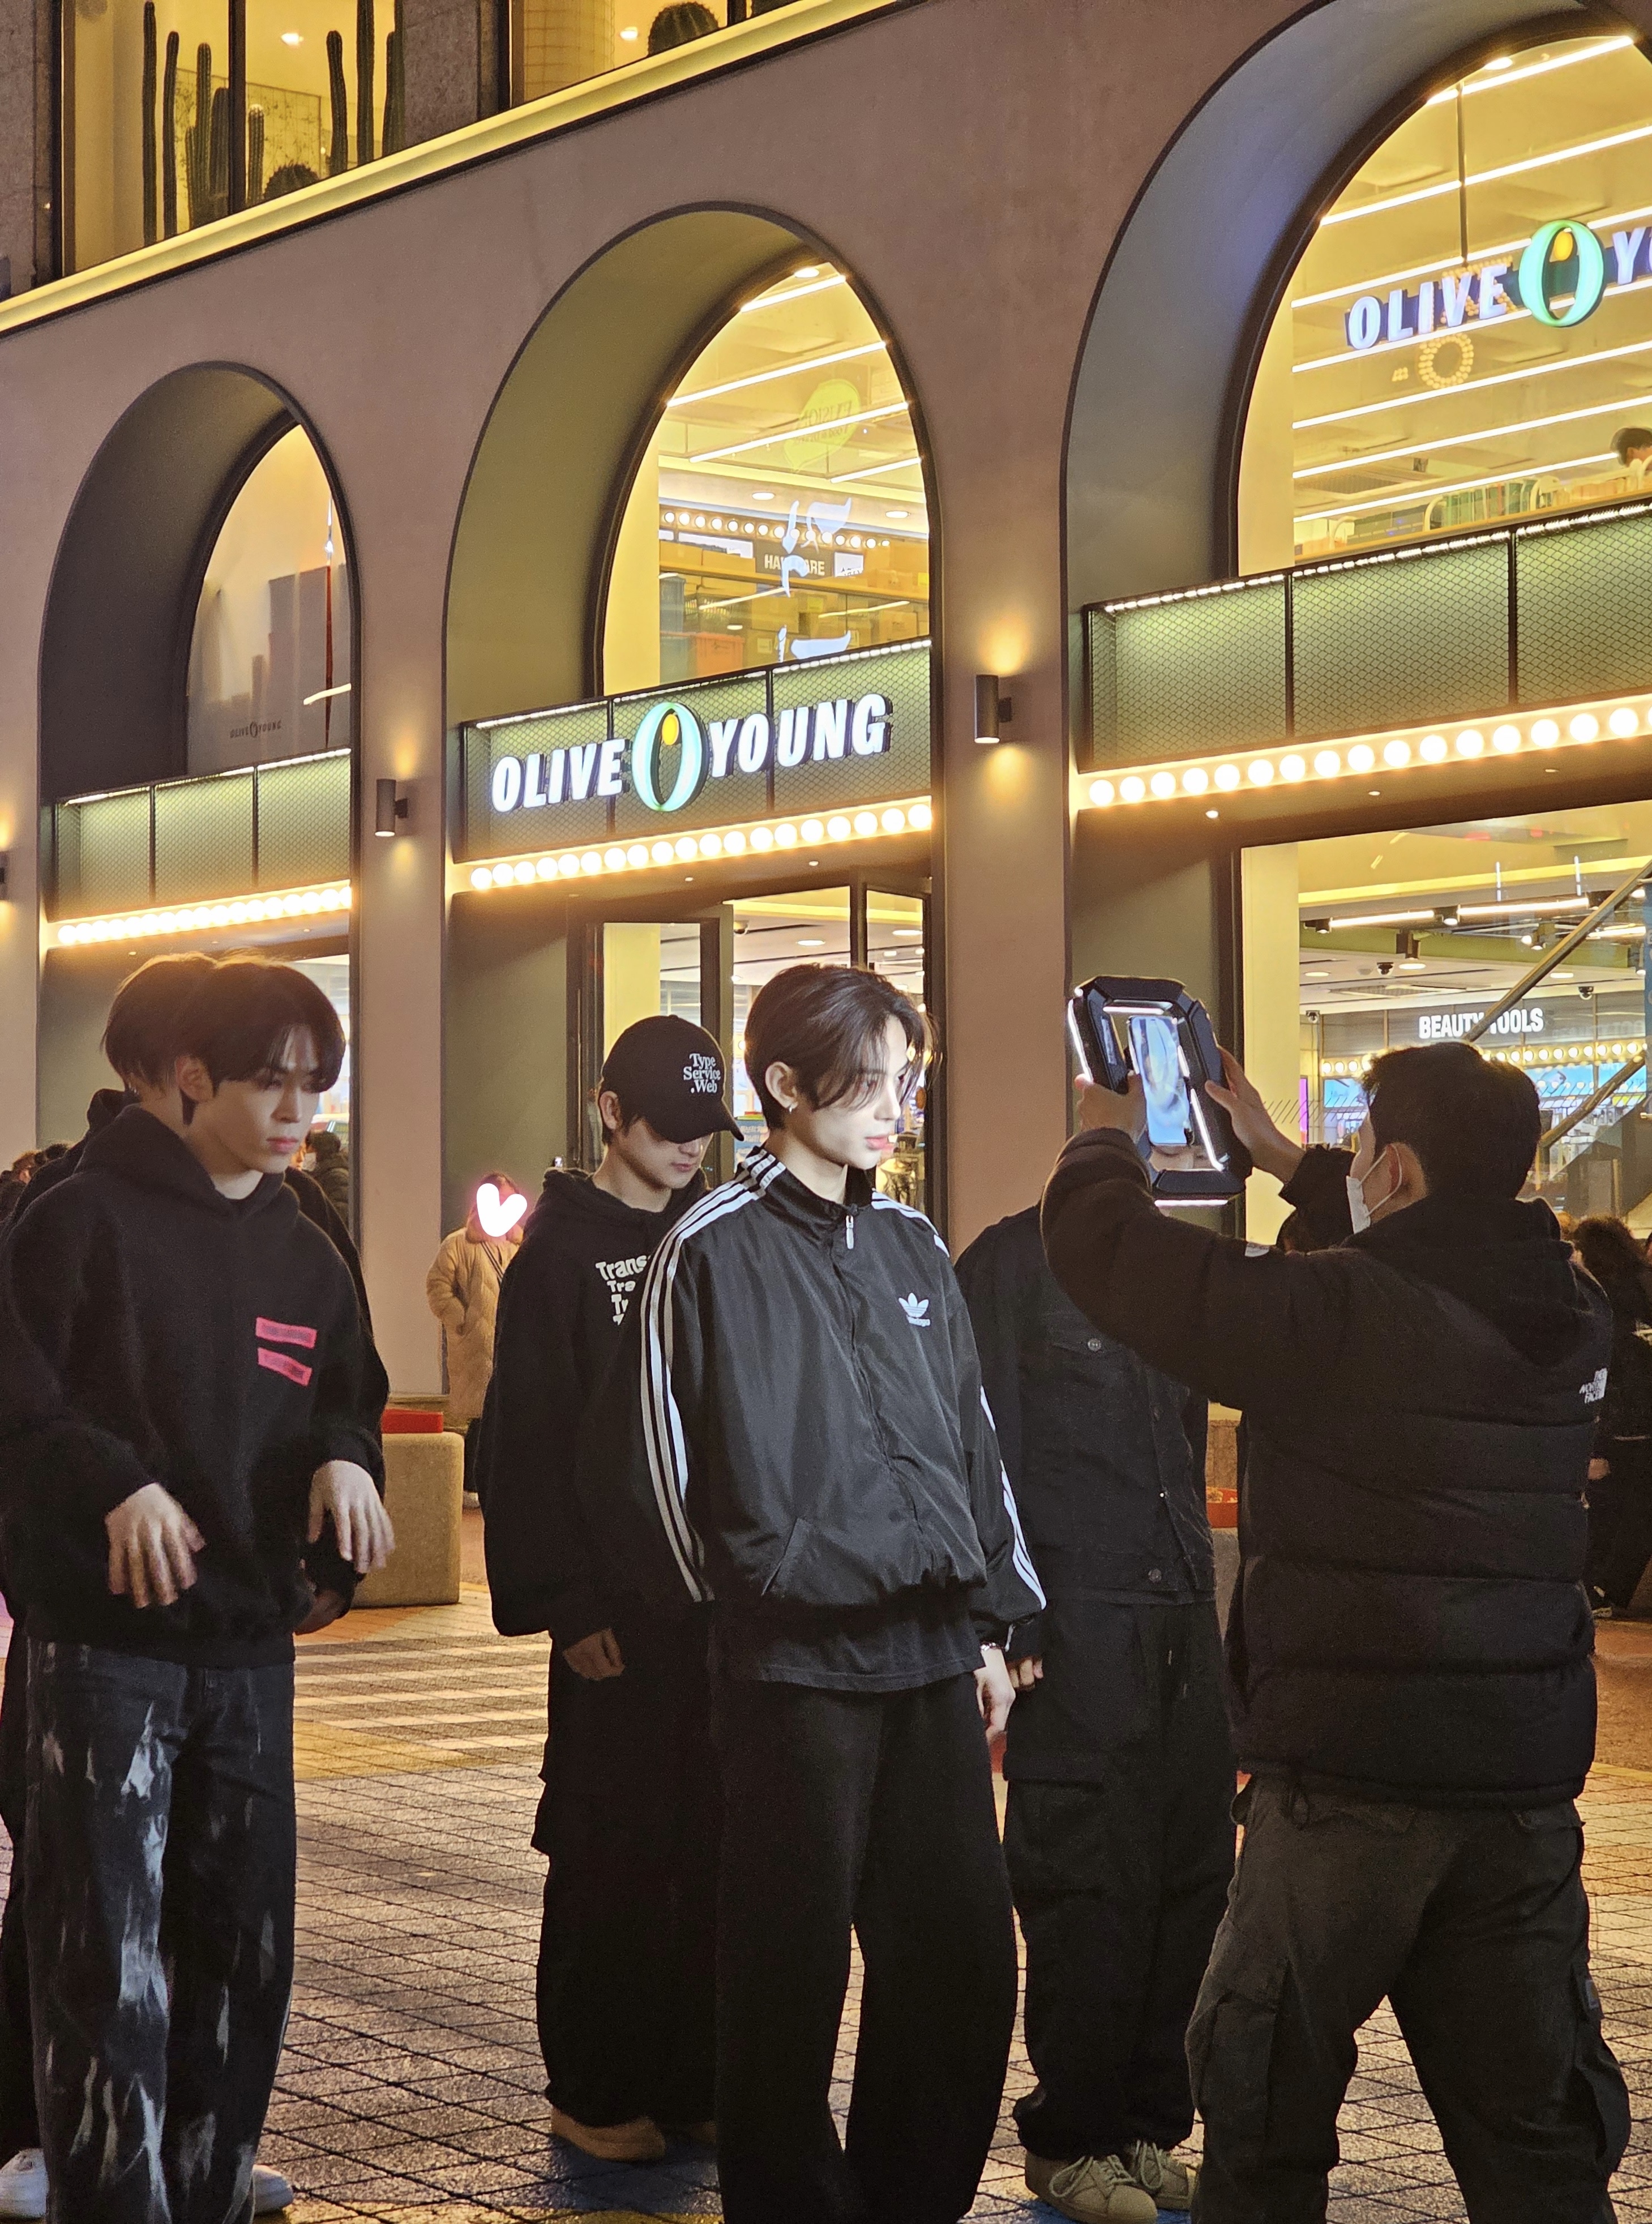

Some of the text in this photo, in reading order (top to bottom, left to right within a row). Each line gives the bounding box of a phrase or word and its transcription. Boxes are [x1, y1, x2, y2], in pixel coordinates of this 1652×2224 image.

[1348, 264, 1508, 350] OLIVE
[1612, 226, 1652, 285] Y
[764, 554, 785, 570] HA
[491, 738, 627, 812] OLIVE
[708, 694, 888, 778] YOUNG
[689, 1053, 716, 1070] Type
[683, 1066, 721, 1080] Service
[691, 1079, 717, 1093] .Web
[596, 1255, 650, 1280] Trans
